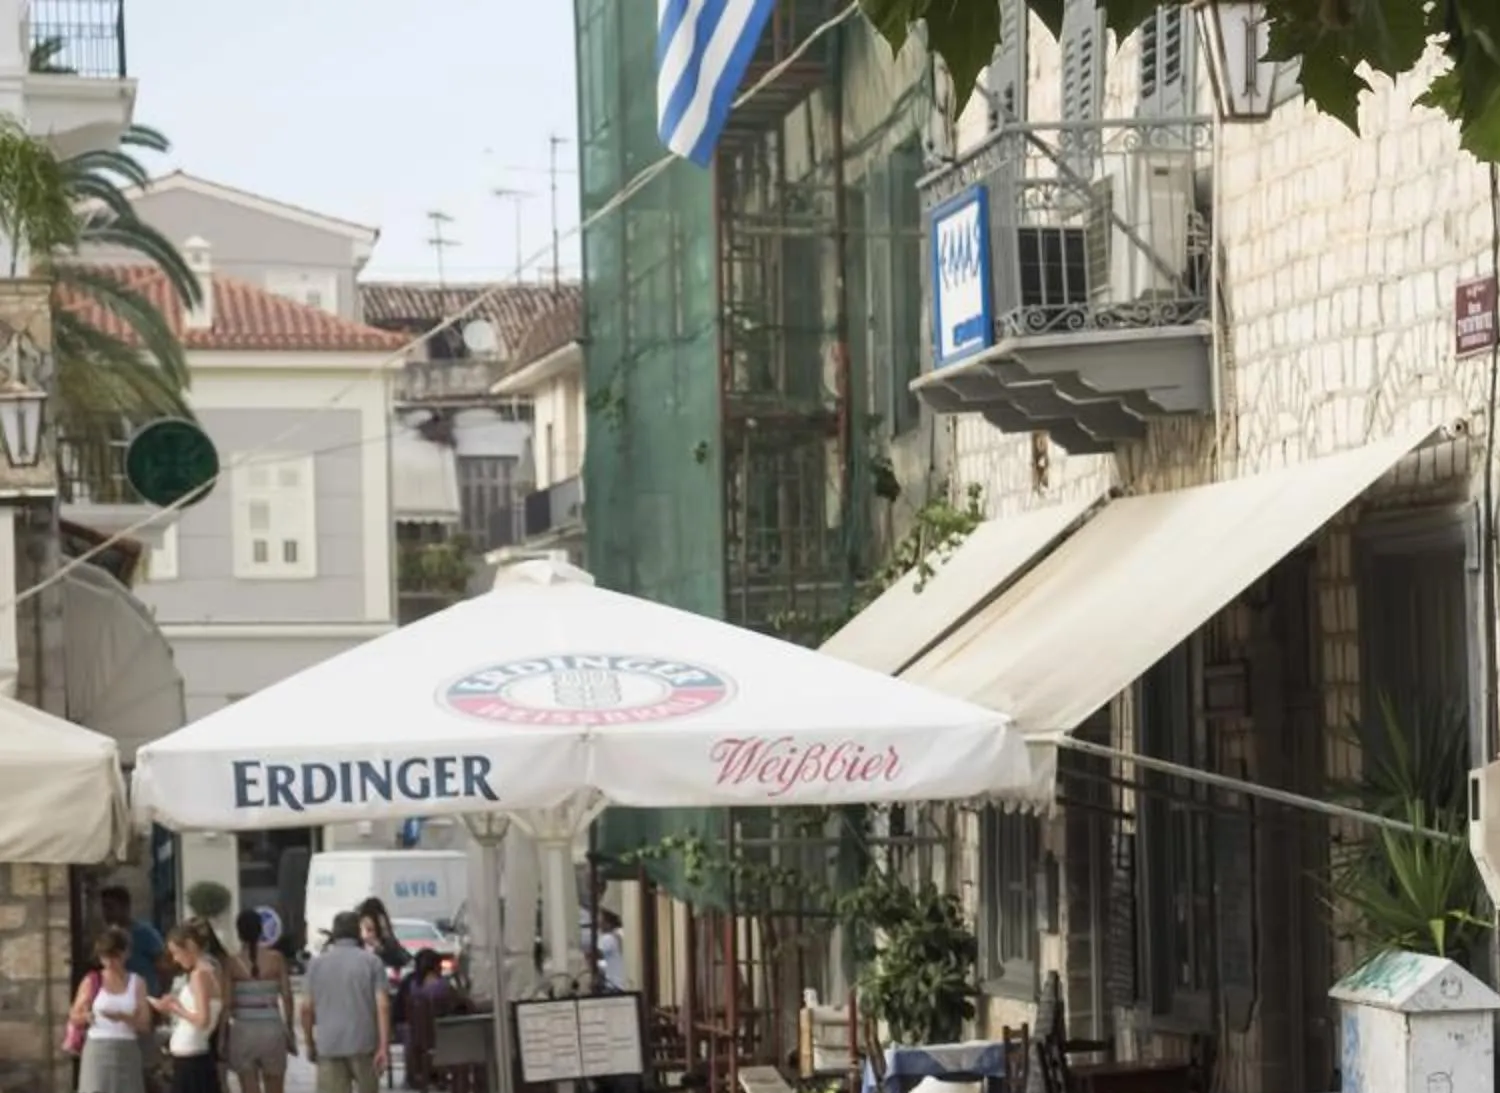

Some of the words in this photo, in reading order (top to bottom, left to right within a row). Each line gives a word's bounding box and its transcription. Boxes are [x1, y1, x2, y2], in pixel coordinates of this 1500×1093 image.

[457, 653, 708, 693] ERDINGER
[232, 756, 499, 813] ERDINGER
[710, 737, 904, 796] Weißbier
